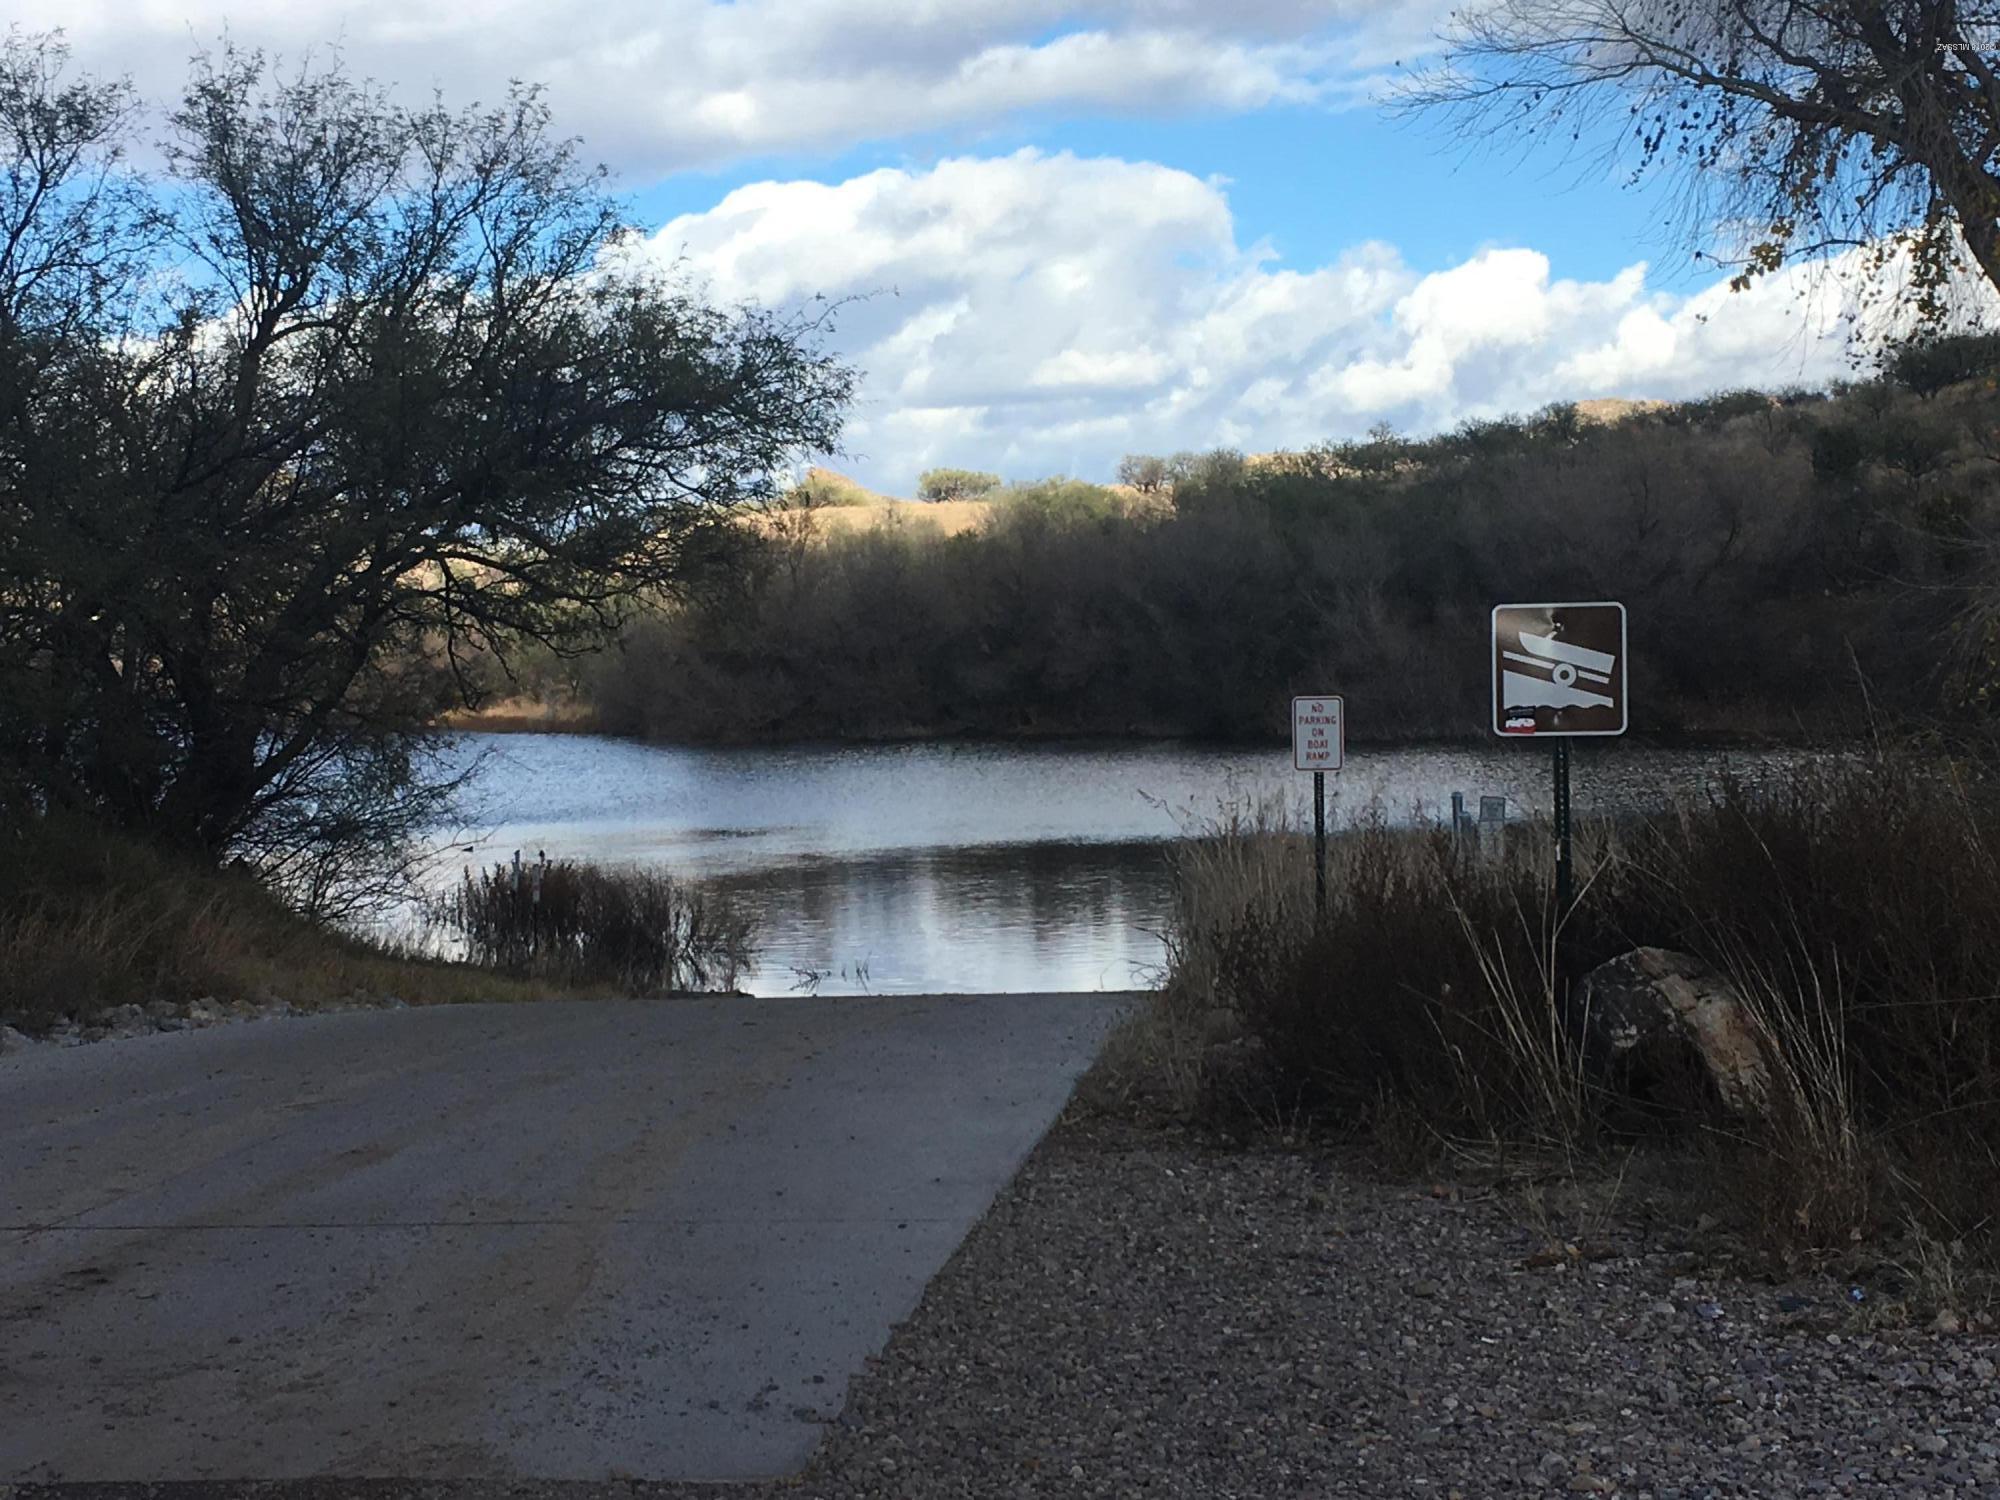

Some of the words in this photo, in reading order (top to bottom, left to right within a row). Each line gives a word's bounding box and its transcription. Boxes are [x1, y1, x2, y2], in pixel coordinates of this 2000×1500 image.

[1311, 703, 1324, 713] NO
[1298, 715, 1336, 725] PARKING
[1311, 727, 1324, 737] ON
[1307, 739, 1328, 749] BOAT
[1305, 751, 1330, 761] RAMP
